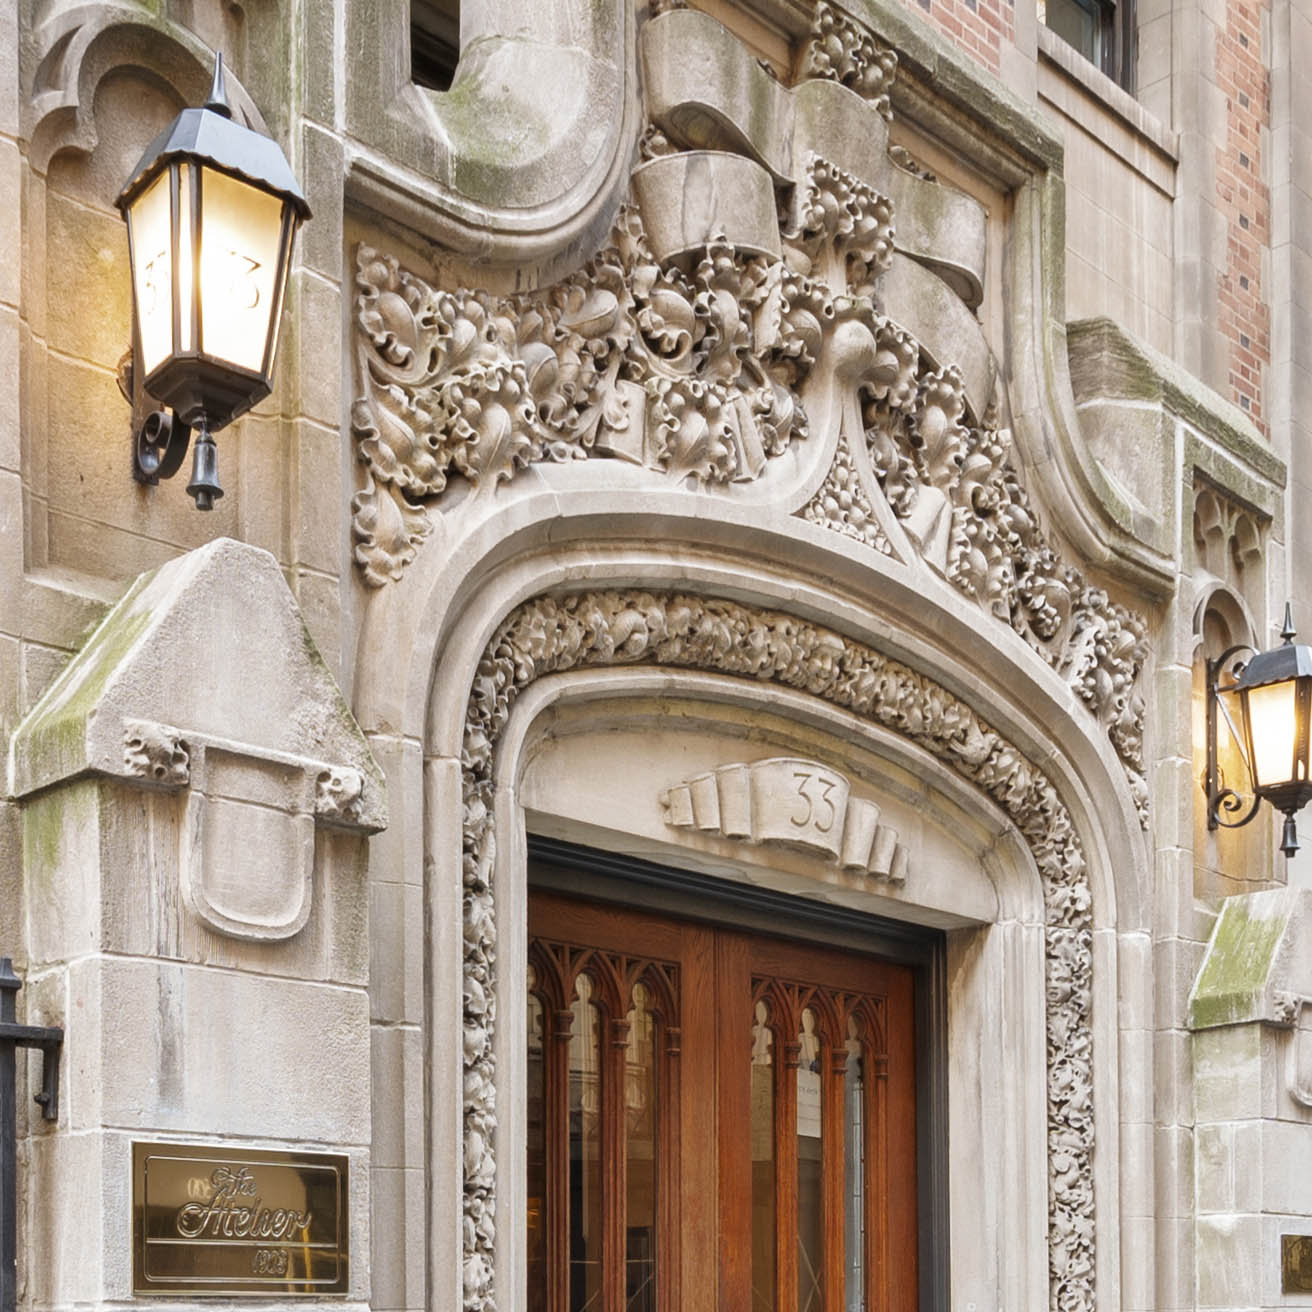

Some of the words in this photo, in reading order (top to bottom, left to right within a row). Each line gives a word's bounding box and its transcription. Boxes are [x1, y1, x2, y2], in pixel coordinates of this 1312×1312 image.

[790, 773, 837, 833] 33
[210, 1167, 257, 1199] The
[176, 1188, 312, 1238] Atelier
